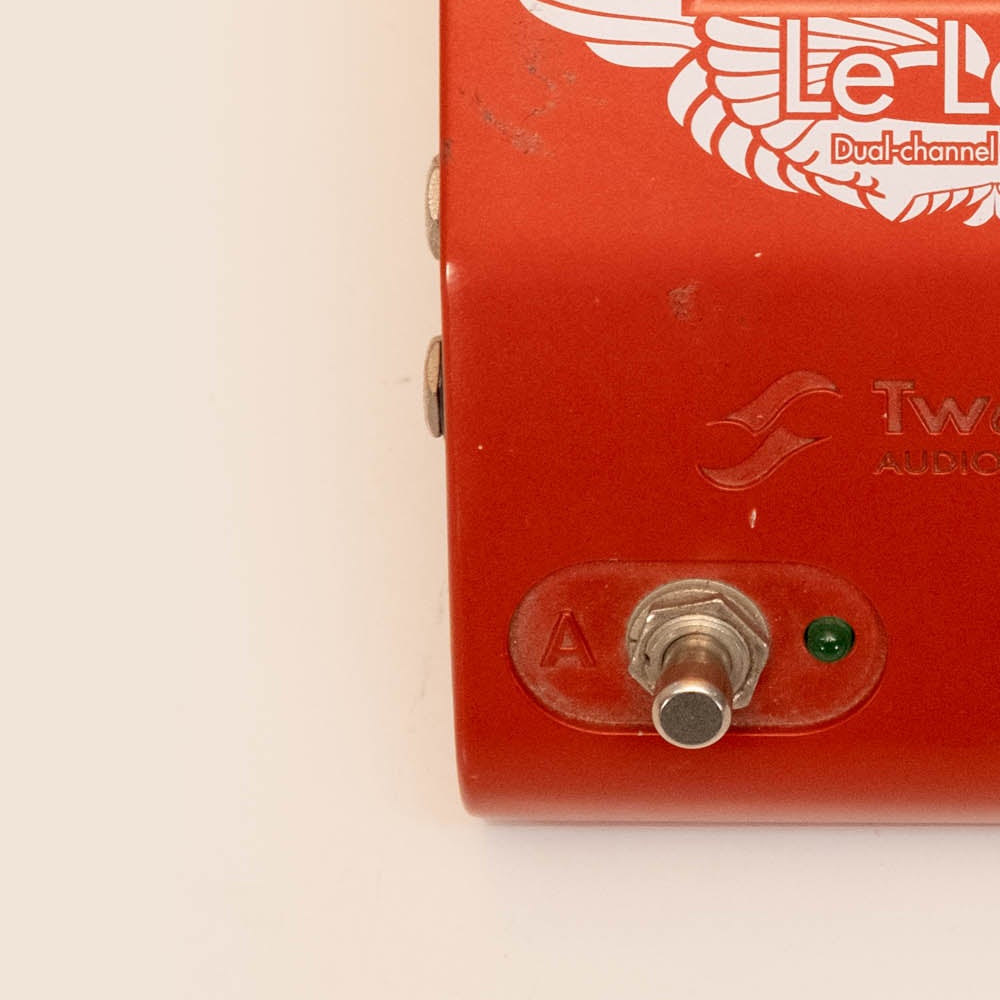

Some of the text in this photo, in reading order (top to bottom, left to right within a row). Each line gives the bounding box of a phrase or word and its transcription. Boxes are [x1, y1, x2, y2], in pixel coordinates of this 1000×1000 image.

[785, 18, 896, 116] Le
[834, 132, 998, 164] Dual-channel
[540, 610, 596, 668] A
